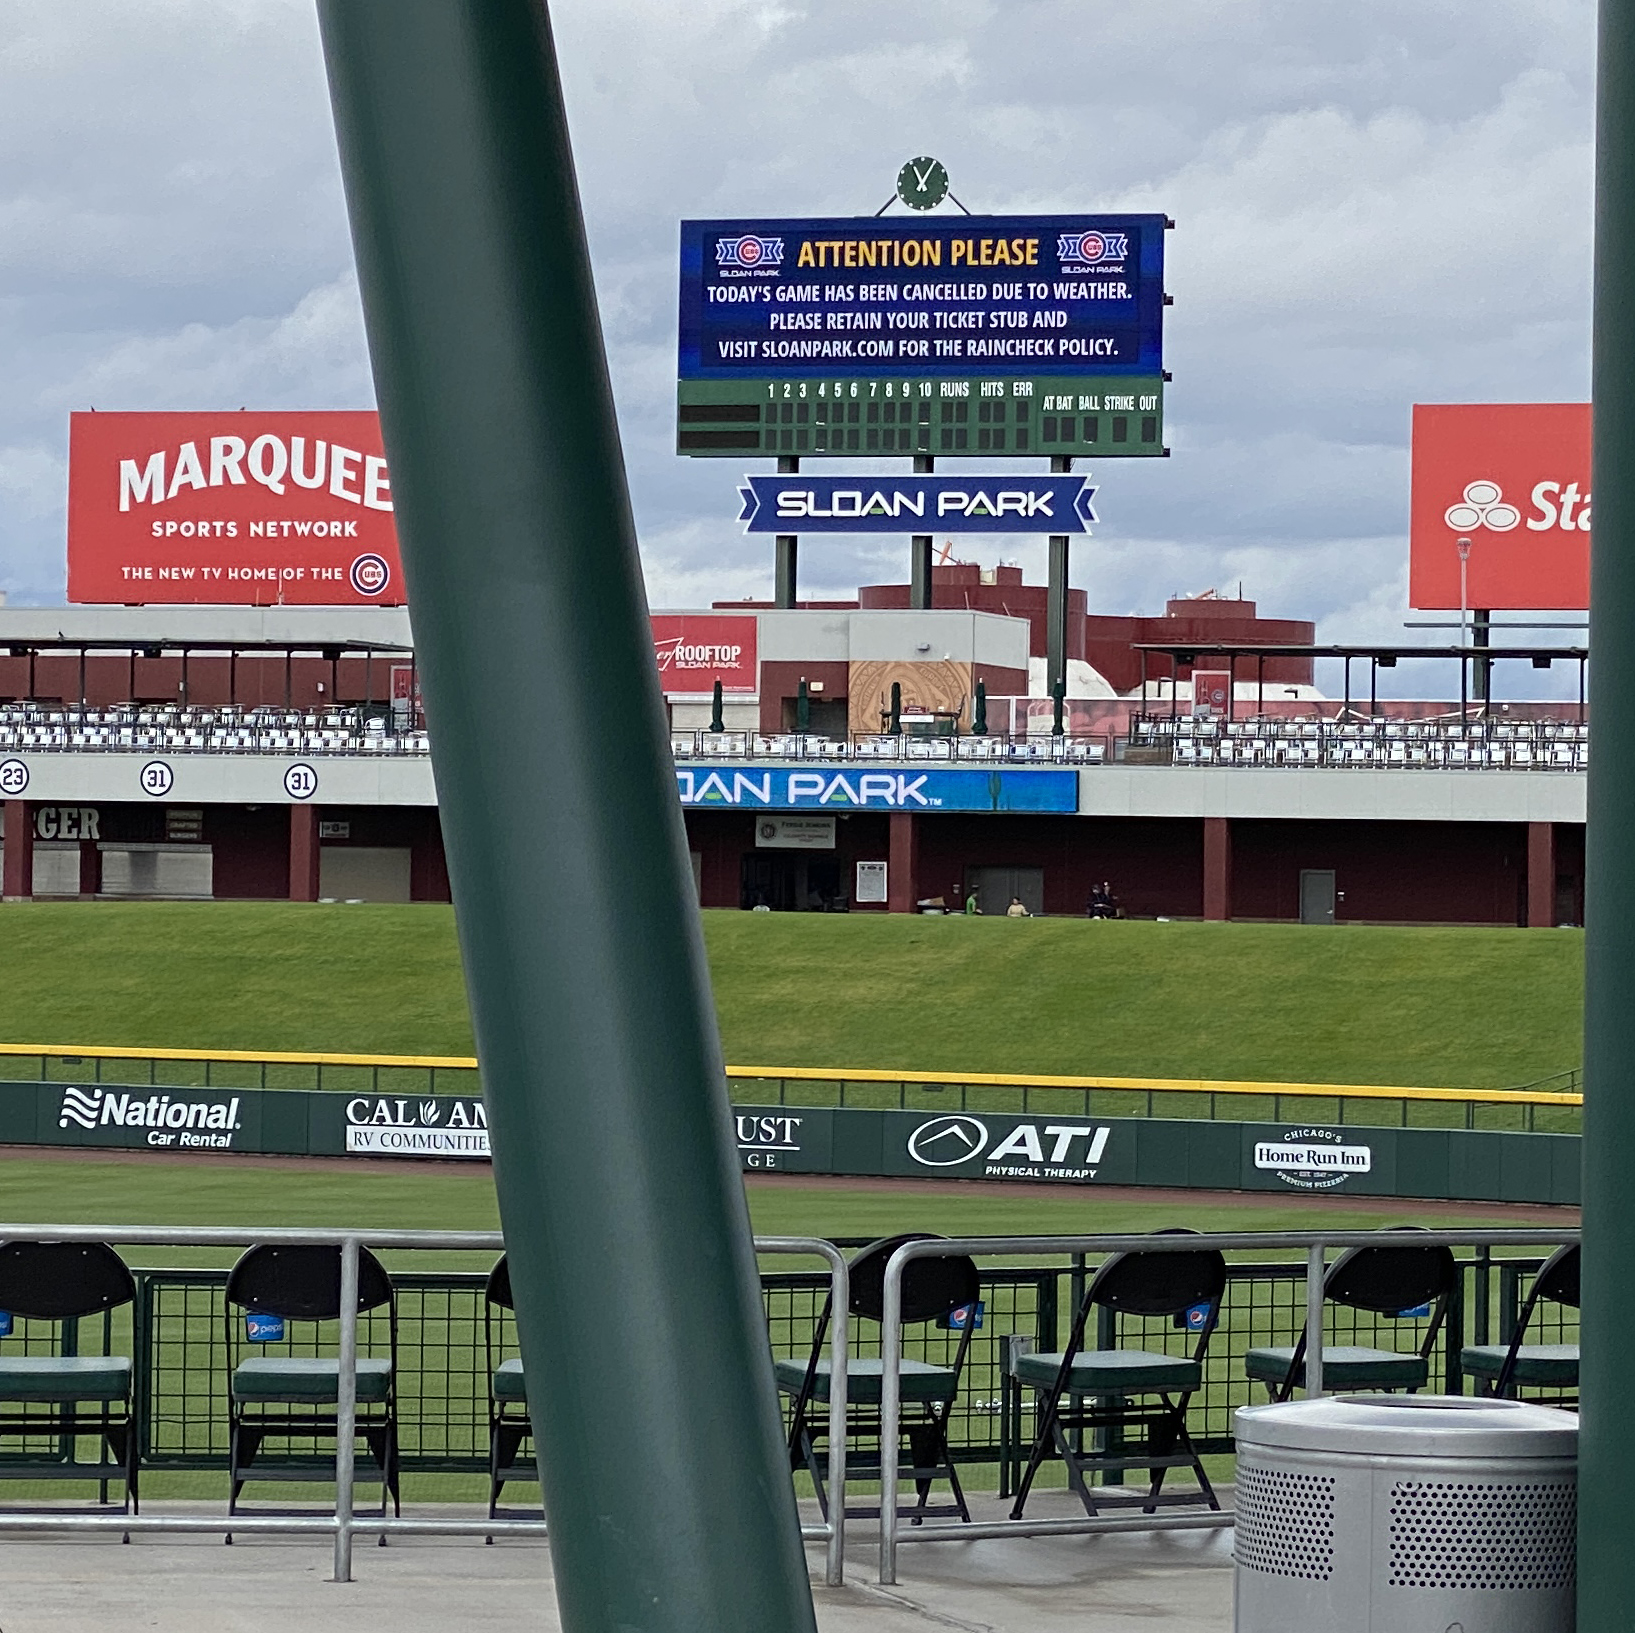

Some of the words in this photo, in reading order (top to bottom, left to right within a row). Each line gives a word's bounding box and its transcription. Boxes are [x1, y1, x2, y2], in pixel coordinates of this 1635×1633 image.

[797, 240, 942, 268] ATTENTION
[951, 238, 1040, 267] PLEASE
[719, 269, 752, 278] SLOAN
[754, 269, 780, 277] PARK
[1061, 266, 1095, 274] SLOAN
[1096, 266, 1123, 274] PARK
[707, 285, 771, 303] TODAY'S
[775, 285, 820, 302] GAME
[825, 284, 855, 302] HAS
[859, 284, 898, 301] BEEN
[903, 283, 987, 301] CANCELLED
[992, 283, 1023, 300] DUE
[1027, 282, 1049, 300] TO
[1053, 282, 1133, 300] WEATHER.
[770, 312, 822, 330] PLEASE
[826, 311, 882, 330] RETAIN
[886, 311, 930, 329] YOUR
[933, 311, 985, 329] TICKET
[989, 310, 1028, 329] STUB
[1032, 310, 1068, 328] AND
[718, 340, 759, 358] VISIT
[761, 340, 894, 358] SLOANPARK.COM
[899, 339, 930, 357] FOR
[933, 339, 963, 357] THE
[967, 338, 1055, 356] RAINCHECK
[1059, 338, 1119, 356] POLICY.
[768, 383, 775, 398] 1
[783, 383, 791, 398] 2
[799, 383, 807, 398] 3
[818, 382, 826, 397] 4
[834, 382, 842, 398] 5
[850, 382, 858, 398] 6
[869, 382, 877, 397] 7
[885, 382, 893, 397] 8
[902, 382, 910, 397] 9
[918, 382, 932, 397] 10
[940, 381, 970, 397] RUNS
[980, 381, 1004, 397] HITS
[1012, 381, 1033, 397] ERR
[1042, 396, 1054, 411] AT
[1056, 396, 1074, 411] BAT
[1078, 395, 1101, 411] BALL
[1104, 395, 1135, 411] STRIKE
[1139, 395, 1158, 411] OUT
[118, 433, 395, 512] MARQUEE
[775, 490, 925, 518] SLOAN
[937, 490, 1055, 518] PARK
[151, 520, 239, 538] SPORTS
[249, 520, 359, 538] NETWORK
[122, 566, 153, 580] THE
[158, 566, 196, 580] NEW
[201, 567, 223, 580] TV
[227, 567, 278, 580] HOME
[282, 567, 305, 580] OF
[310, 567, 343, 580] THE
[675, 645, 741, 662] ROOFTOP
[675, 661, 710, 669] SLOAN
[713, 661, 741, 669] PARK
[3, 768, 24, 785] 23
[147, 769, 166, 788] 31
[291, 772, 310, 790] 31
[676, 771, 771, 804] OAN
[788, 773, 928, 805] PARK
[32, 806, 100, 840] GER
[346, 1098, 417, 1127] CAL
[354, 1131, 374, 1146] RV
[735, 1116, 800, 1143] UST
[1283, 1128, 1343, 1144] CHICAGO'S
[147, 1131, 176, 1146] Car
[179, 1132, 233, 1147] Rental
[986, 1124, 1111, 1164] ATI
[747, 1153, 776, 1168] GE
[1258, 1148, 1304, 1163] Home
[1306, 1149, 1338, 1167] Run
[1341, 1151, 1366, 1166] Inn
[985, 1165, 1041, 1177] PHYSICAL
[1044, 1167, 1097, 1179] THERAPY
[1276, 1170, 1313, 1189] PREMIUM
